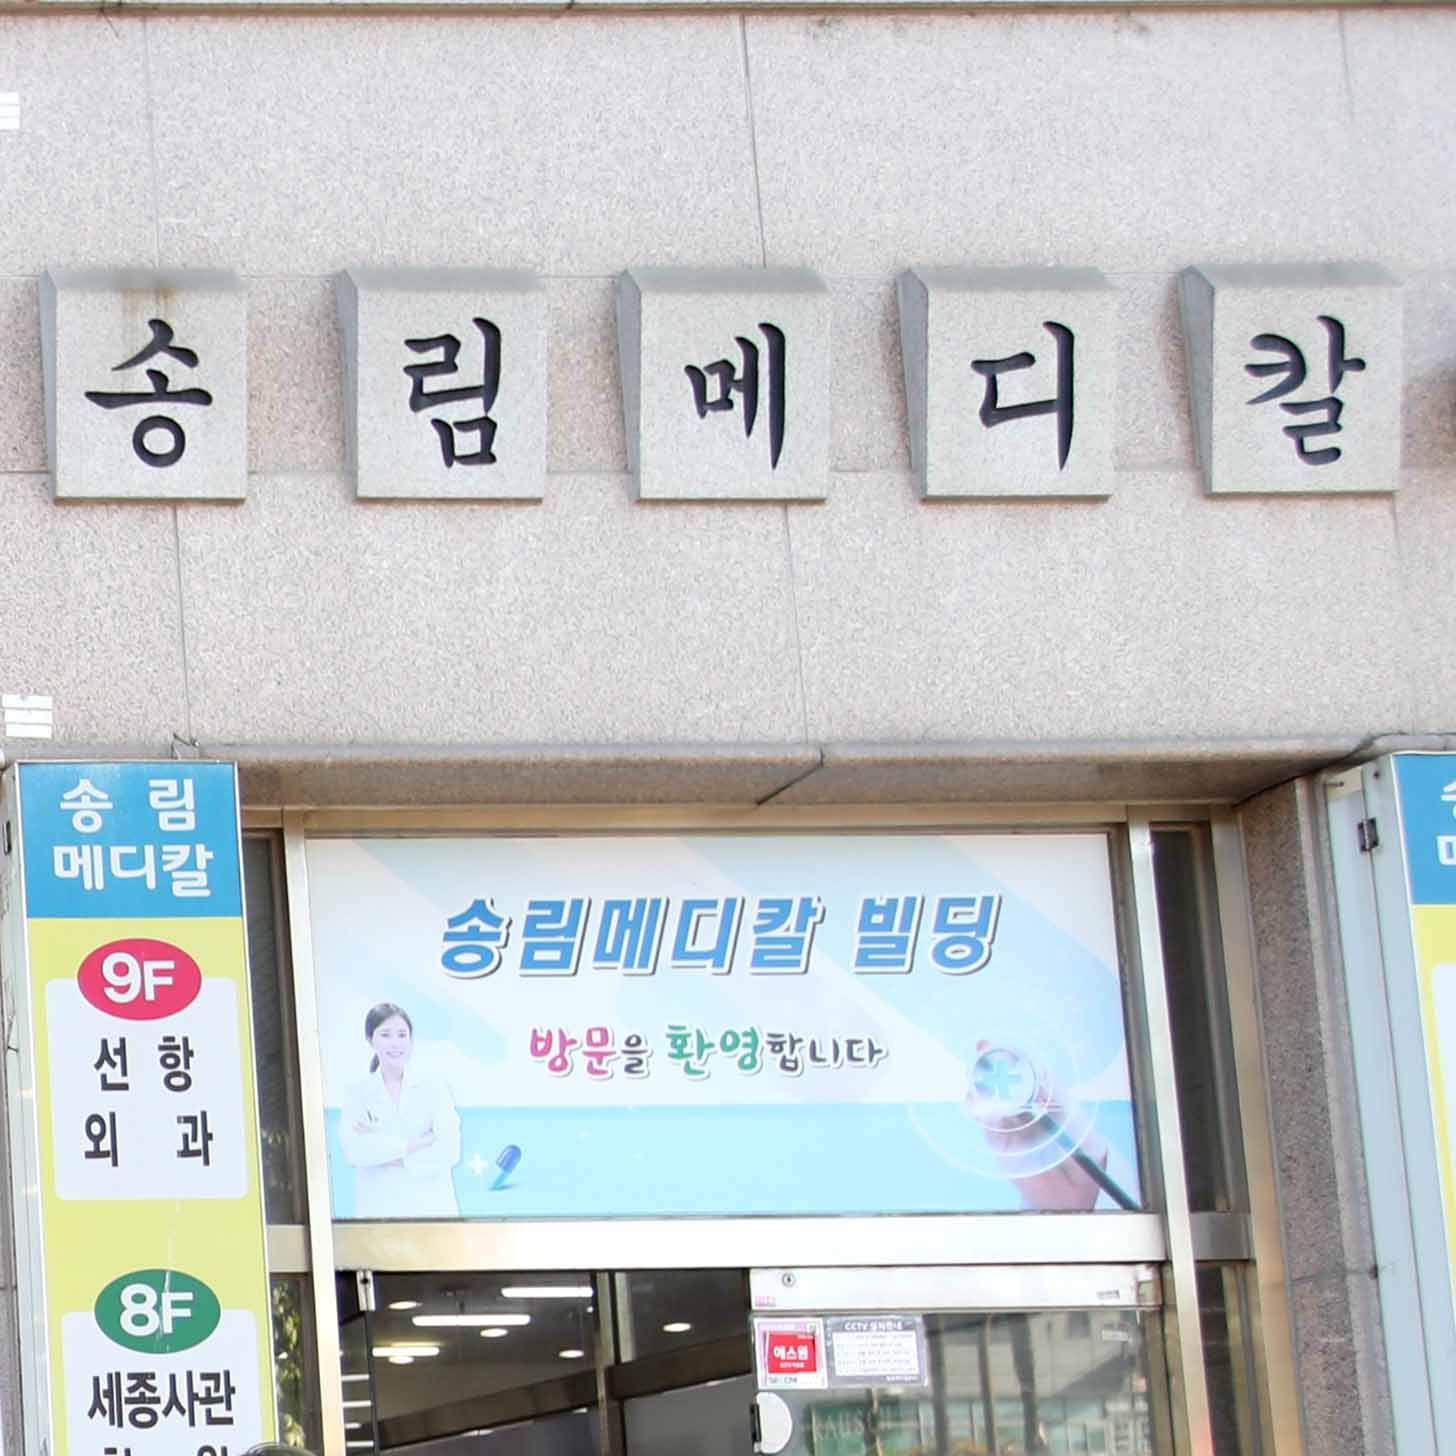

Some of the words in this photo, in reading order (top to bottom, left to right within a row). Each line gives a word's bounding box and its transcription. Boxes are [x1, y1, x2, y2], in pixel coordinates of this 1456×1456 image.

[53, 843, 215, 898] 메디칼
[441, 893, 826, 976] 송림메디칼
[855, 892, 1004, 974] 빌딩
[102, 951, 175, 1004] 9F
[529, 1024, 650, 1076] 방문을
[664, 1022, 886, 1078] 환영합니다
[120, 1283, 193, 1337] 8F
[88, 1369, 236, 1429] 세종사관
